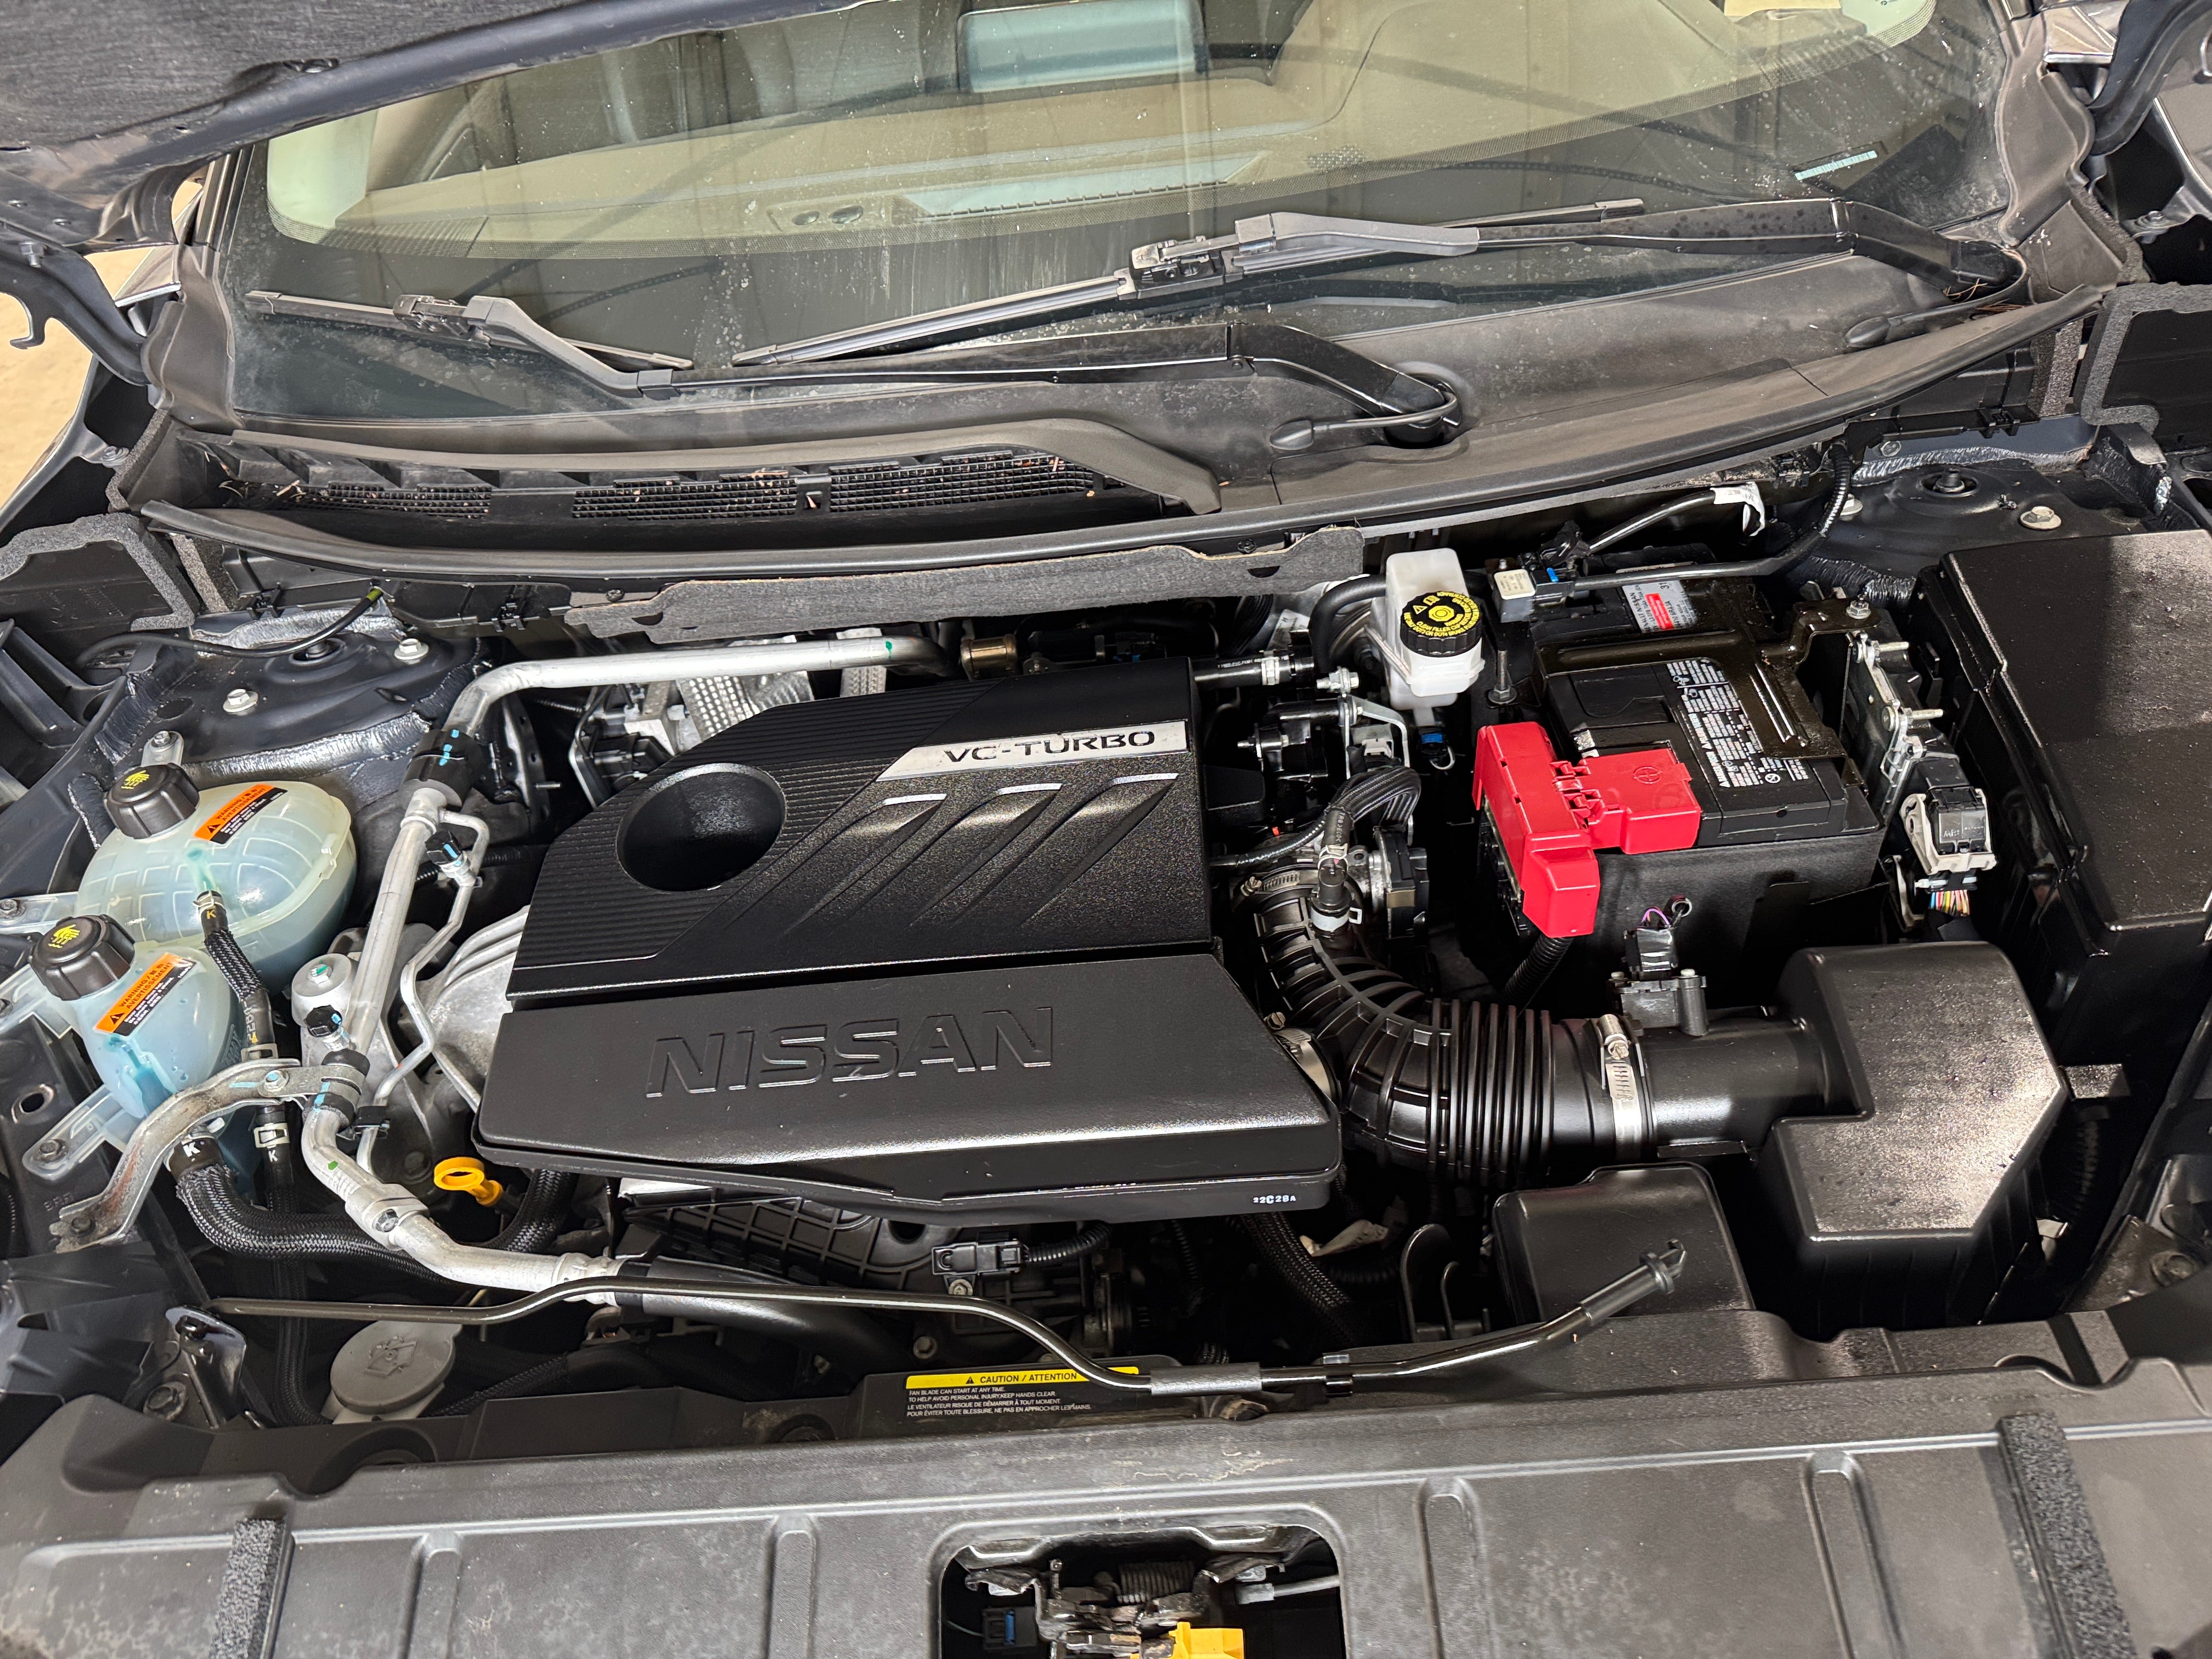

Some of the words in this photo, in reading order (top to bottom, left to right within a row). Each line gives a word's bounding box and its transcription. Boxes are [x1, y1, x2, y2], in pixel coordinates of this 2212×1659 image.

[1417, 621, 1433, 631] CLEAN
[943, 730, 1156, 763] VC-TURBO
[215, 799, 243, 819] WARNING
[206, 909, 217, 919] K
[119, 979, 148, 1007] WARNING
[126, 962, 173, 1009] AVERTISSEMENT
[647, 1006, 1052, 1098] NISSAN
[183, 1141, 201, 1158] K
[268, 1149, 278, 1163] K
[980, 1375, 1019, 1384] CAUTION
[1029, 1373, 1077, 1381] ATTENTION
